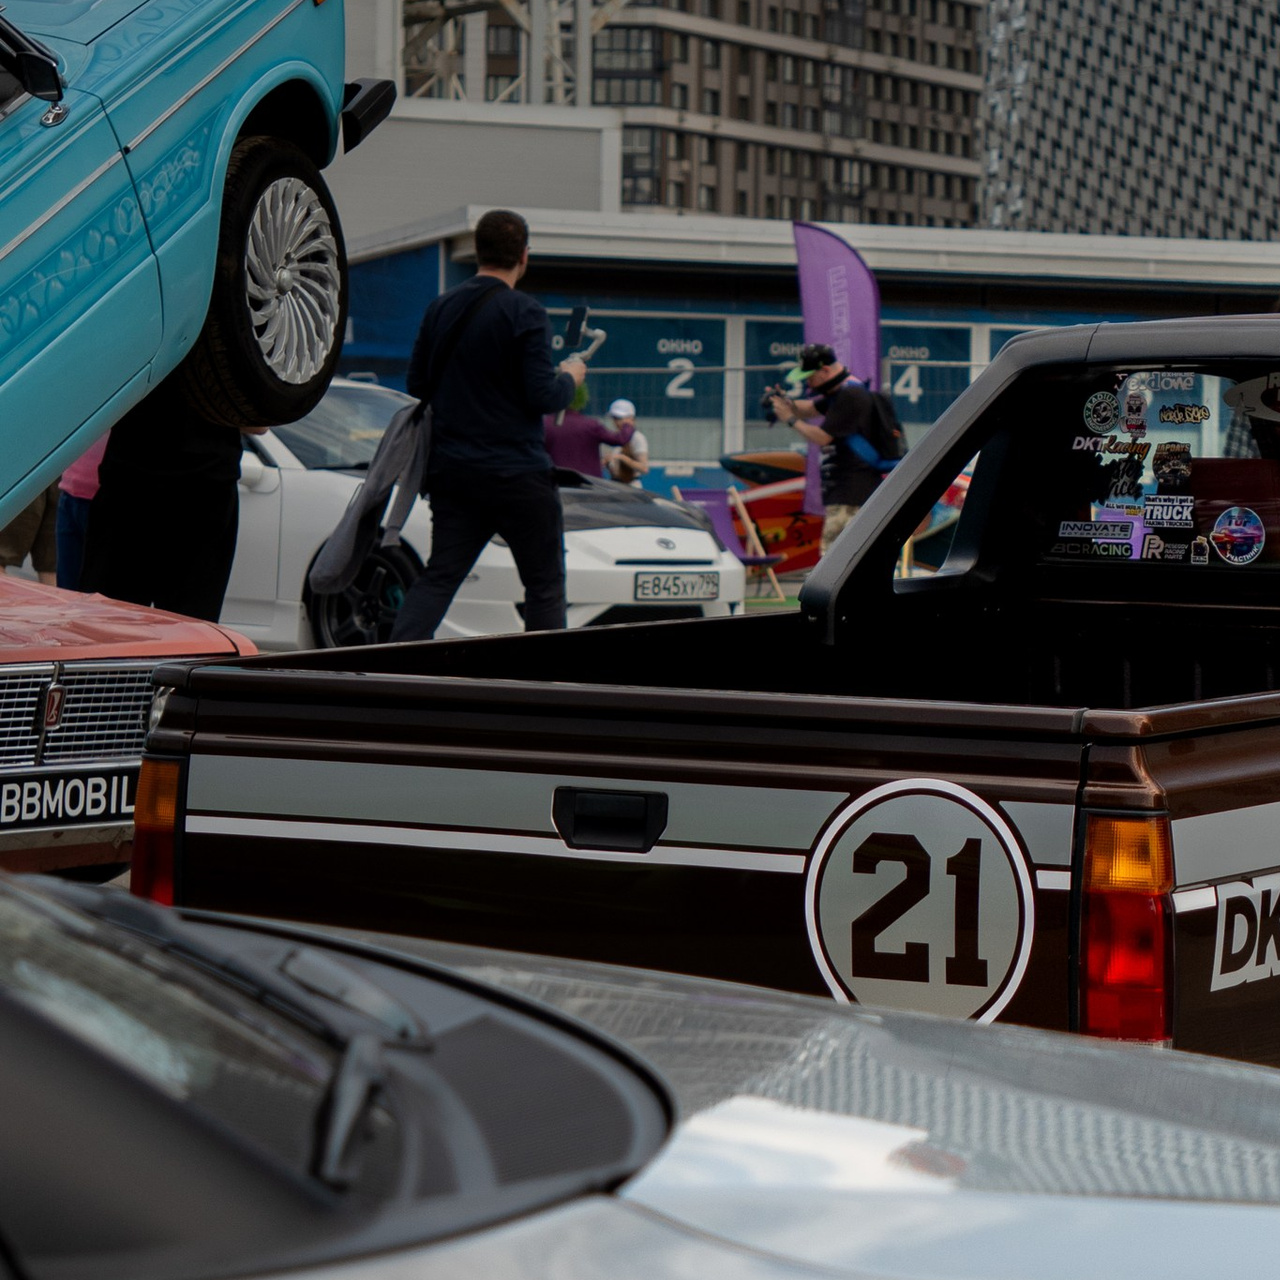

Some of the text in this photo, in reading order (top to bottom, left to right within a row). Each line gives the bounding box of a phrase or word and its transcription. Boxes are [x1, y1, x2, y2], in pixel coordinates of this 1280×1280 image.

[656, 338, 703, 355] ОКНО
[769, 341, 804, 357] ОКН
[888, 345, 930, 359] ОКНО
[665, 357, 695, 399] 2
[893, 364, 923, 404] 4
[1072, 436, 1107, 451] DKT
[1145, 505, 1194, 520] TRUCK
[1062, 523, 1130, 532] INNOVATE
[1081, 543, 1132, 556] RACING
[851, 832, 989, 987] 21
